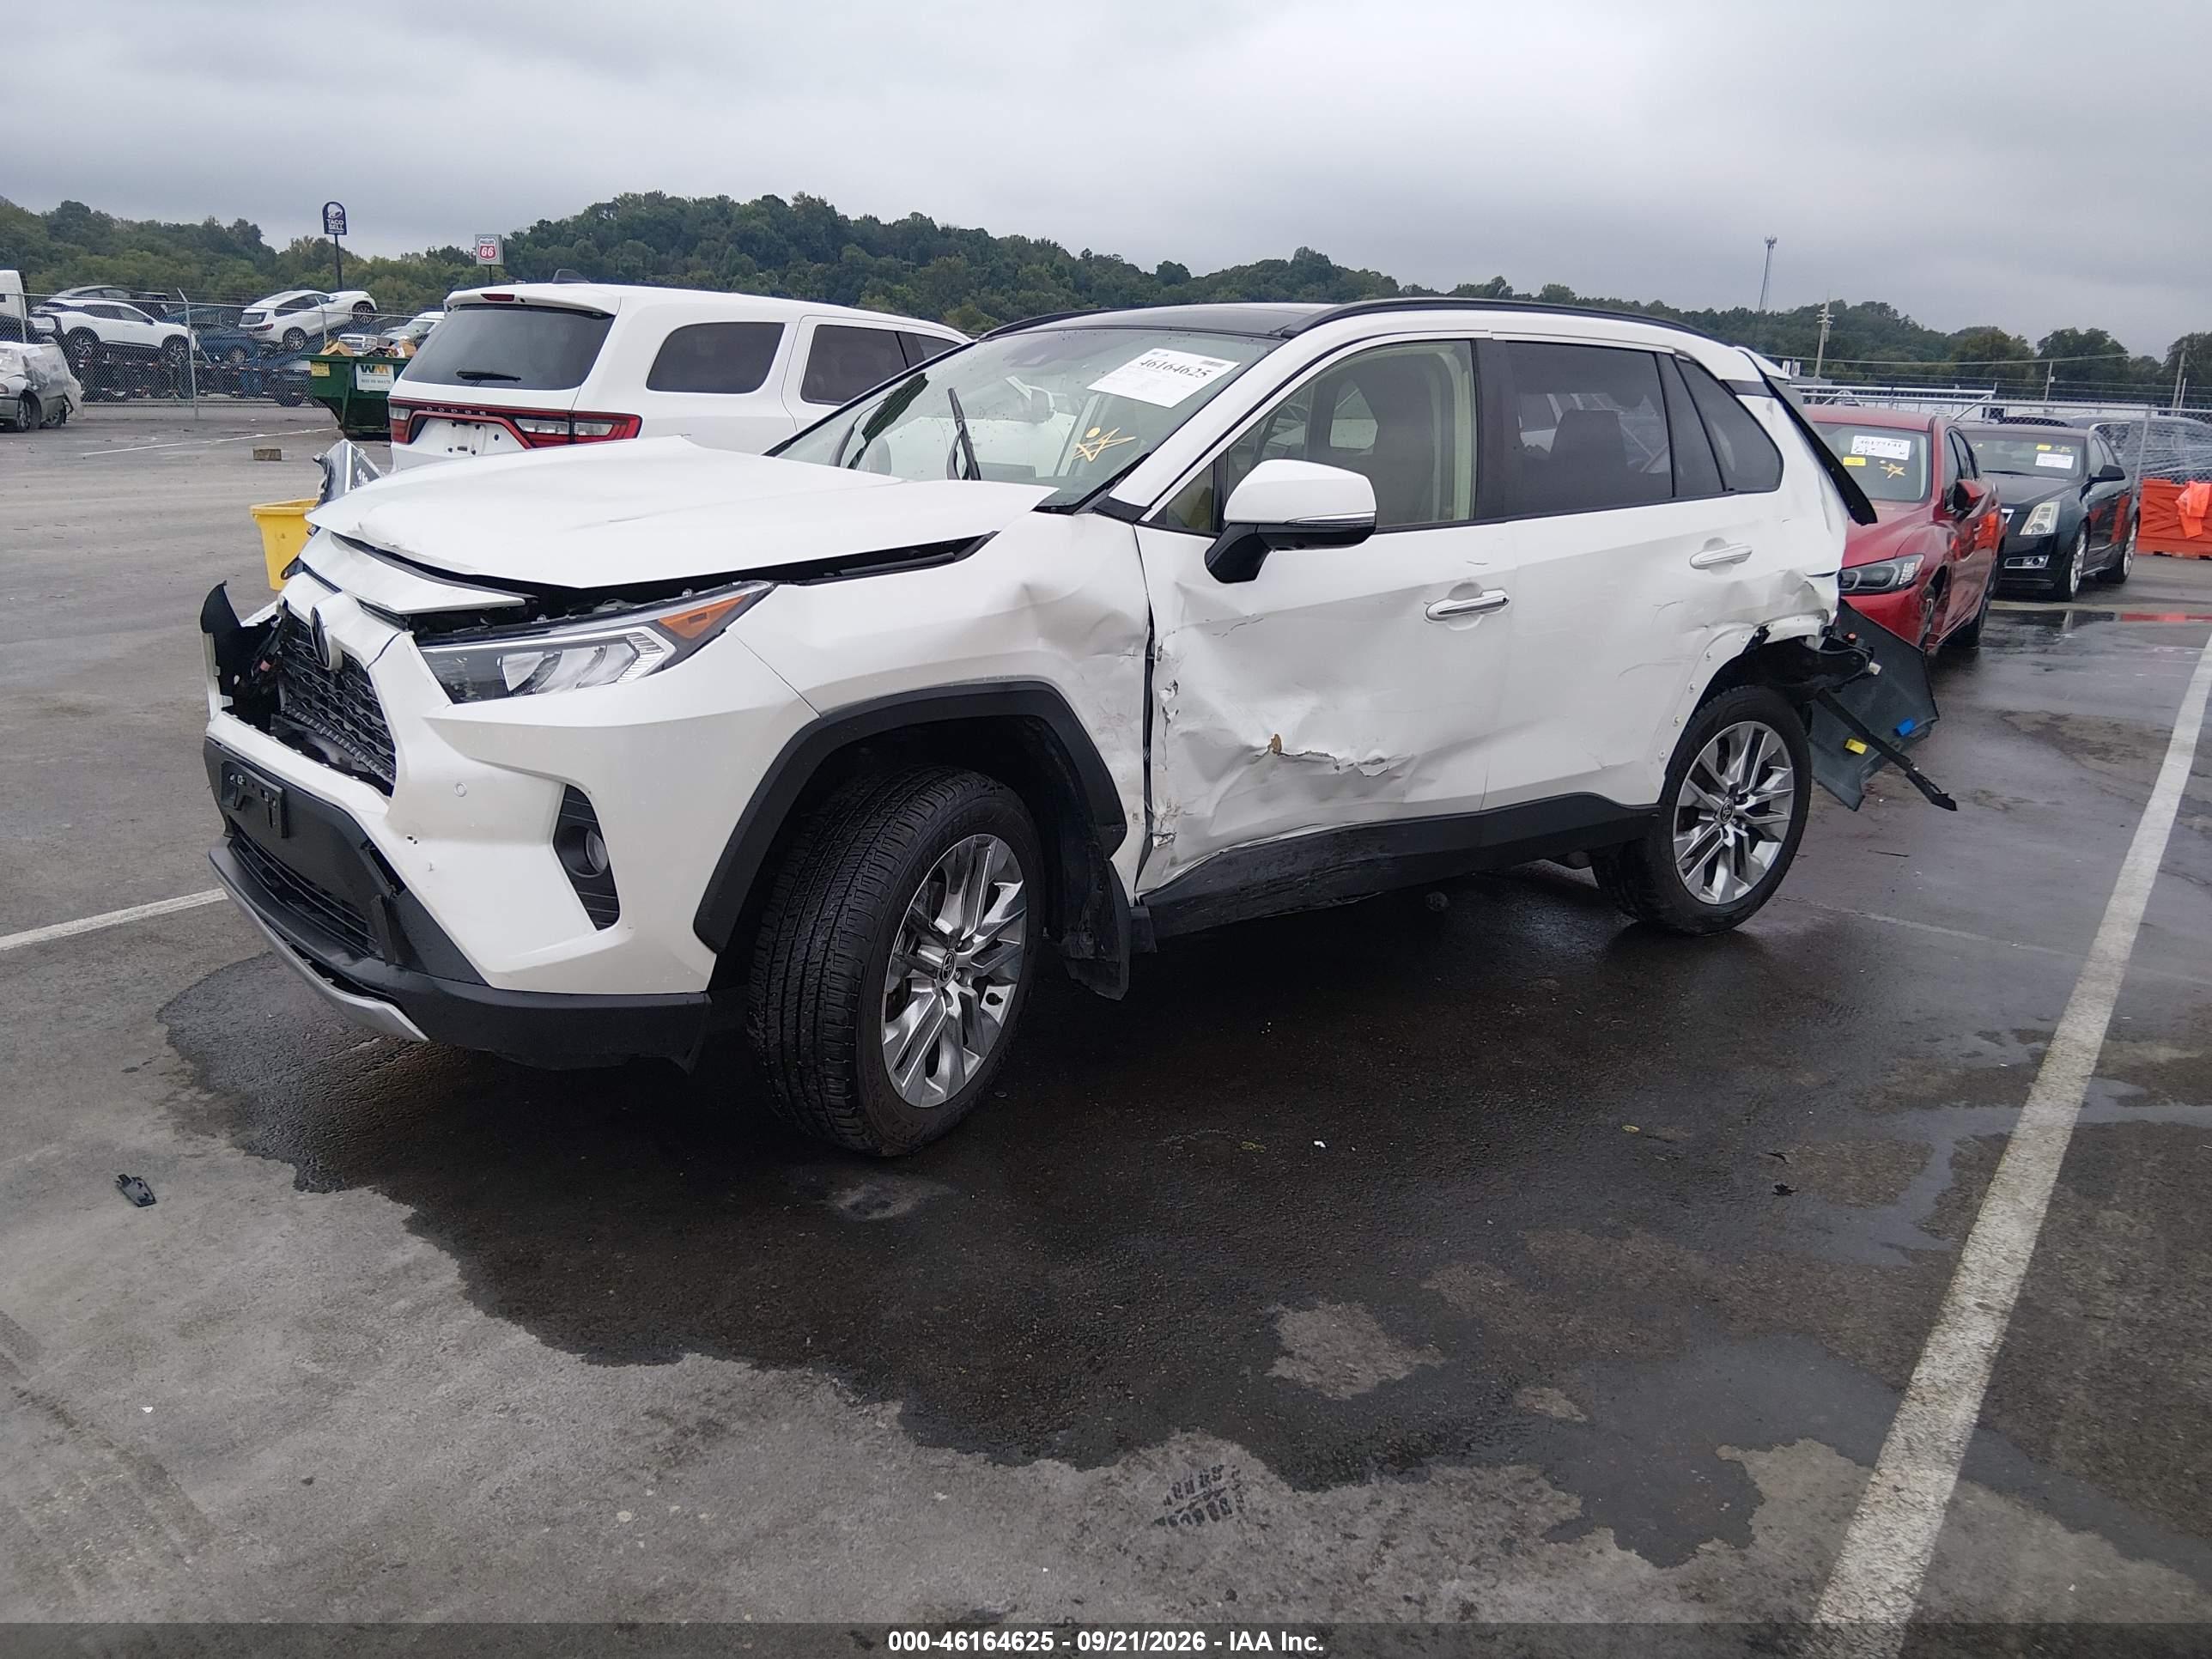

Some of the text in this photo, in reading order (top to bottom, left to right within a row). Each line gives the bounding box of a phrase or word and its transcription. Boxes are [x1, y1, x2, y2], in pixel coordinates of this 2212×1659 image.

[481, 246, 495, 257] 66
[361, 364, 389, 374] WM
[1140, 359, 1212, 378] 46164625
[426, 406, 487, 416] DODGE
